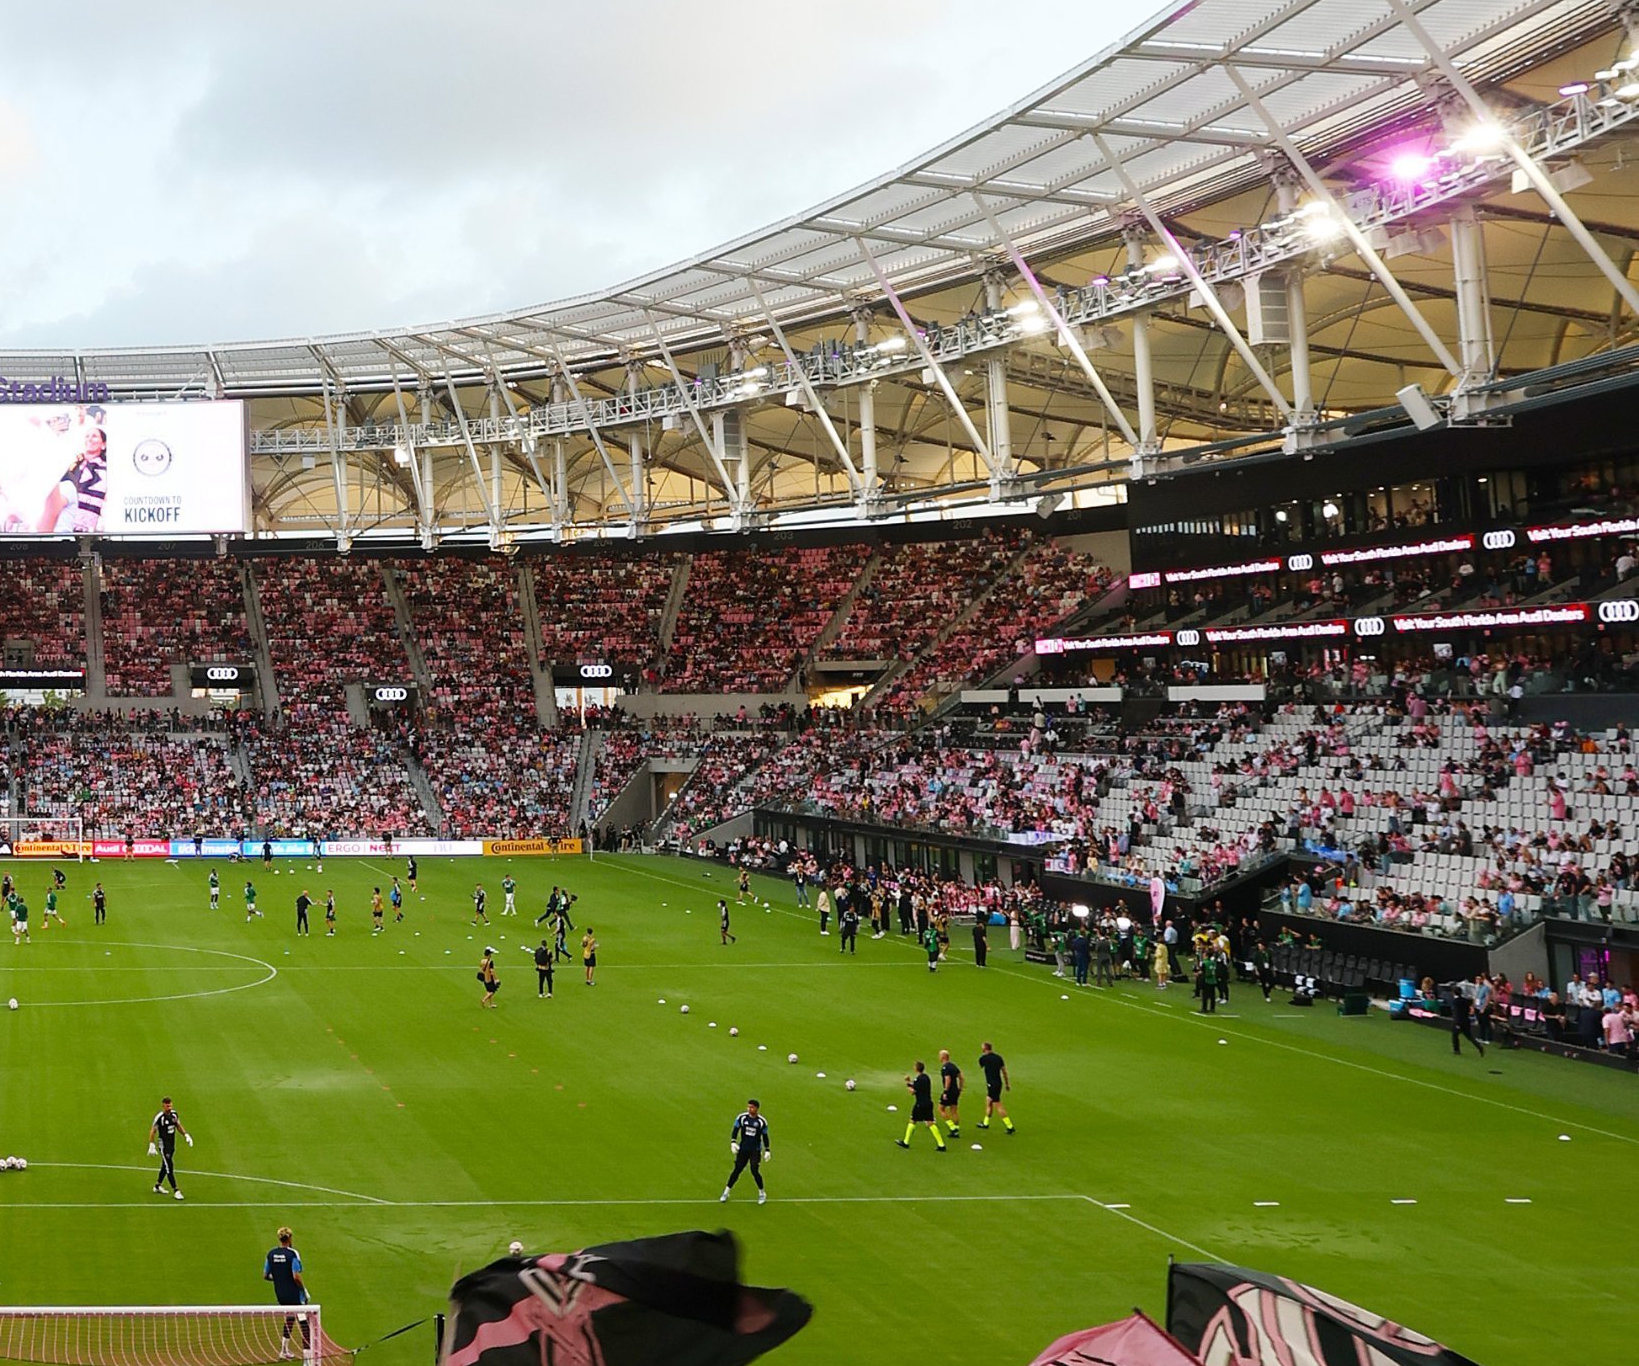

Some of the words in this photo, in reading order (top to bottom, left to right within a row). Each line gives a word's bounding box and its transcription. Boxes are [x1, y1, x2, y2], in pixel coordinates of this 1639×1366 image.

[123, 496, 170, 505] COUNTDOWN
[172, 495, 182, 504] TO
[124, 507, 181, 523] KICKOFF
[1527, 529, 1550, 541] Visit
[1549, 528, 1572, 538] Your
[1572, 524, 1602, 537] South
[1602, 520, 1636, 533] Florida
[1322, 554, 1339, 564] Visit
[1338, 553, 1354, 562] Your
[1354, 551, 1377, 561] South
[1376, 547, 1401, 558] Florida
[1401, 546, 1420, 555] Area
[1420, 543, 1438, 553] Audi
[1438, 540, 1471, 551] Dealers
[1166, 573, 1179, 582] Visit
[1178, 572, 1191, 580] Your
[1191, 570, 1208, 579] South
[1208, 568, 1228, 577] Florida
[1228, 567, 1242, 575] Area
[1241, 564, 1255, 573] Audi
[1255, 562, 1279, 572] Dealers
[1394, 619, 1415, 630] Visit
[1414, 618, 1436, 629] Your
[1436, 616, 1463, 628] South
[1463, 614, 1495, 625] Florida
[1495, 613, 1518, 624] Area
[1519, 611, 1543, 623] Audi
[1543, 609, 1584, 621] Dealers
[1206, 631, 1223, 641] Visit
[1222, 631, 1237, 640] Your
[1237, 629, 1258, 639] South
[1257, 627, 1280, 638] Florida
[1280, 626, 1297, 636] Area
[1297, 625, 1314, 635] Audi
[1314, 623, 1345, 634] Dealers
[1063, 641, 1075, 650] Visit
[1074, 640, 1086, 649] Your
[1086, 639, 1102, 648] South
[1101, 638, 1120, 647] Florida
[1120, 637, 1133, 646] Area
[1132, 636, 1145, 645] Audi
[1145, 635, 1169, 645] Dealers
[15, 843, 61, 855] Continental
[71, 843, 91, 854] Tre
[95, 844, 119, 853] Audi
[328, 843, 361, 853] ERGO
[491, 841, 545, 855] Continental
